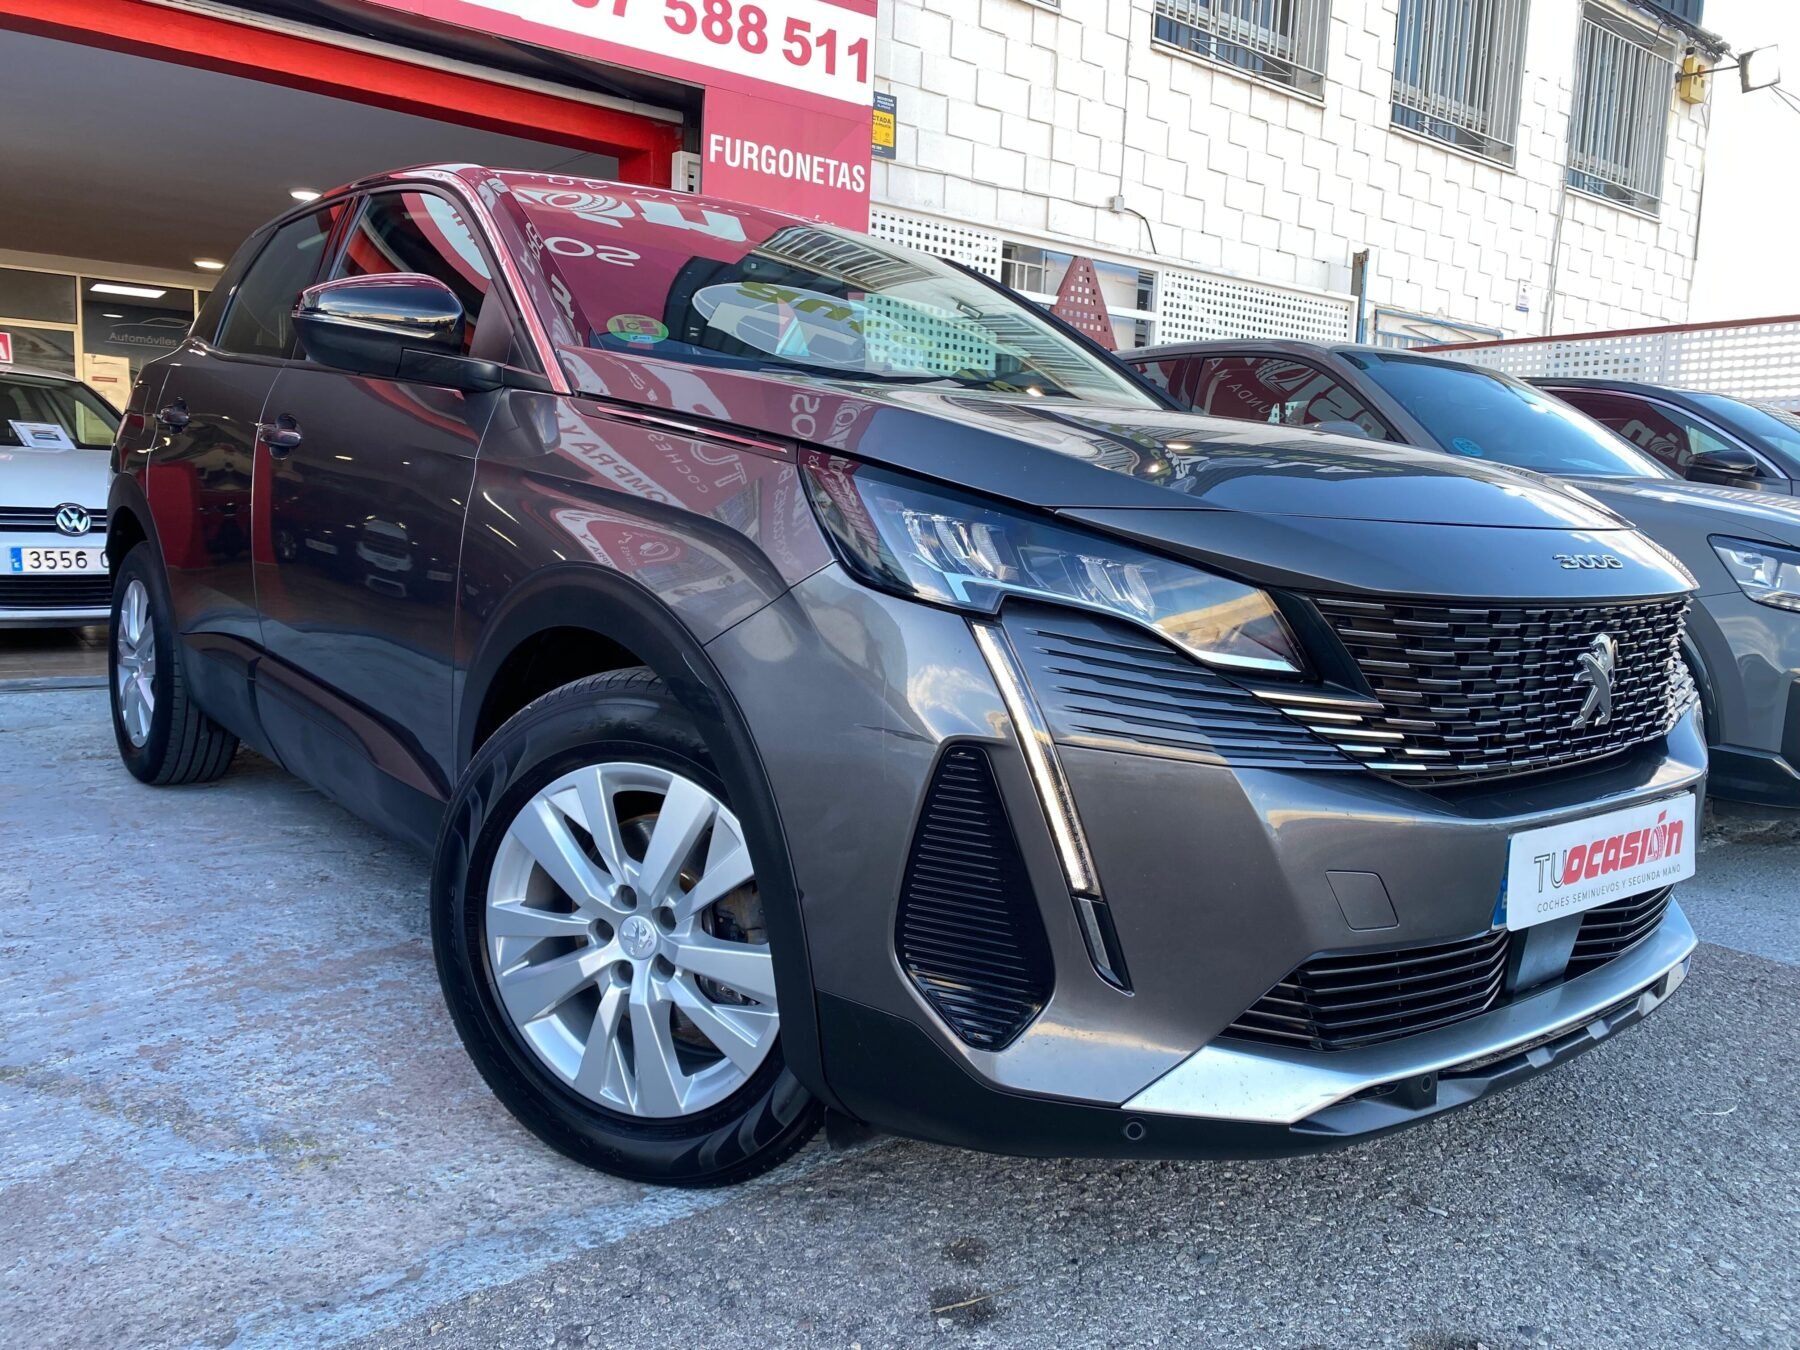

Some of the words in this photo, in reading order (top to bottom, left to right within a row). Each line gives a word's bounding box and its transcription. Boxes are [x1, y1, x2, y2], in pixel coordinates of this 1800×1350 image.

[664, 0, 768, 54] 588
[782, 17, 868, 84] 511
[709, 134, 865, 193] FURGONETAS
[109, 332, 177, 347] Automóviles
[29, 550, 88, 569] 3556
[1552, 554, 1623, 569] 3008
[1537, 896, 1570, 913] COCHES
[1573, 881, 1619, 904] SEMINUEVOS
[1628, 870, 1660, 887] SEGUNDA
[1663, 863, 1680, 877] MANO
